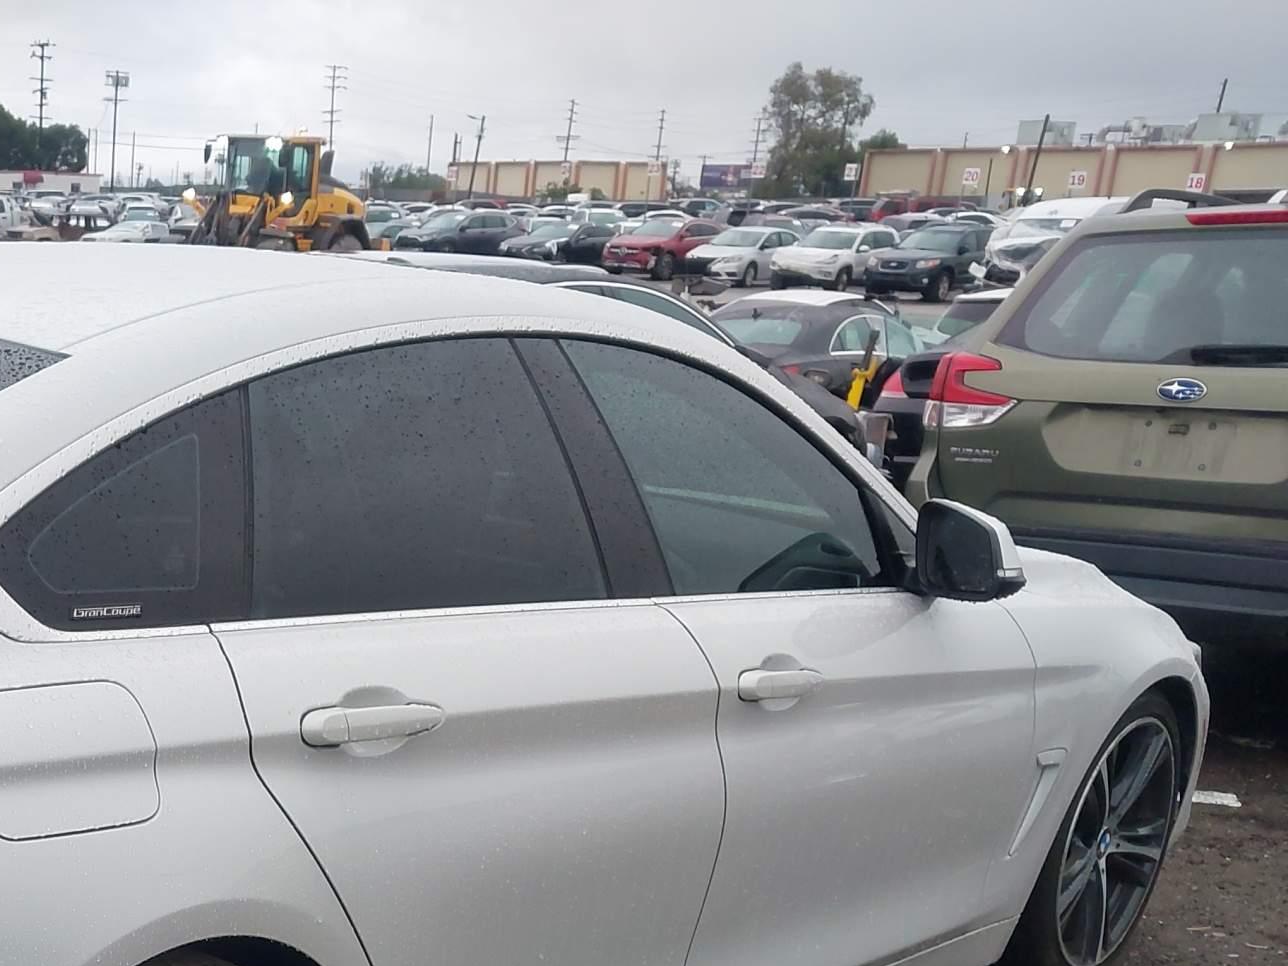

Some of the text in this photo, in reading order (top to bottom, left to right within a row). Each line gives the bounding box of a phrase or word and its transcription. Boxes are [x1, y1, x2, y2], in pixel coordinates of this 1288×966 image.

[964, 170, 979, 182] 20
[1070, 174, 1085, 186] 19
[1187, 177, 1204, 189] 18
[949, 446, 1000, 457] SUBARU
